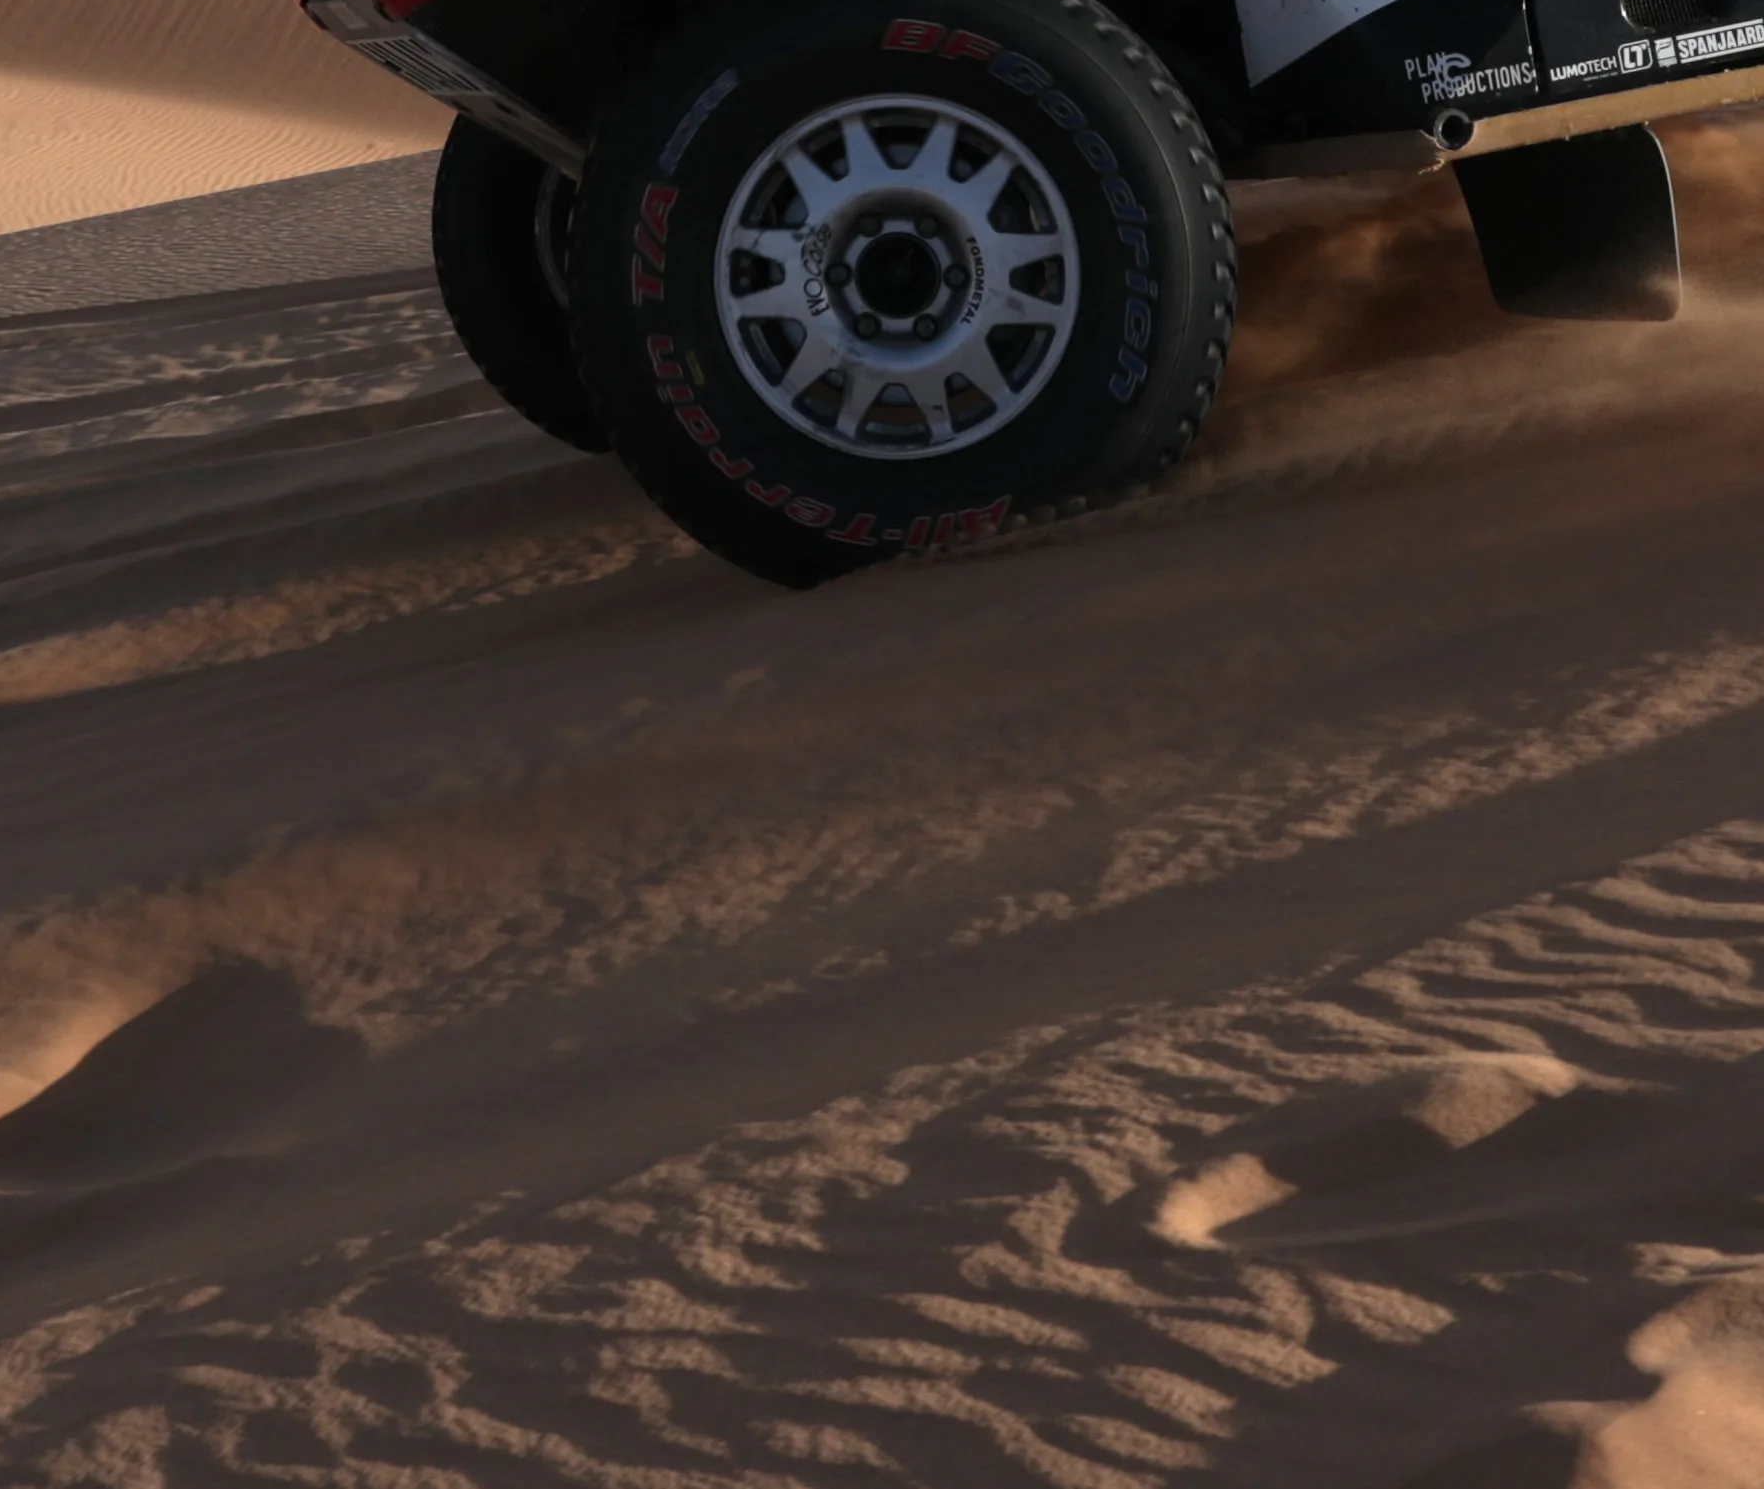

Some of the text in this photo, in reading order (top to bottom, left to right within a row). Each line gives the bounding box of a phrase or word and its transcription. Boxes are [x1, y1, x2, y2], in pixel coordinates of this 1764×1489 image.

[1421, 61, 1533, 105] PRODUCTIONS
[1549, 55, 1617, 82] LUMOTECH
[1622, 43, 1647, 69] LT
[633, 180, 680, 307] T/A
[881, 17, 1159, 403] BFGoodrich
[959, 236, 986, 324] FONDMETAL
